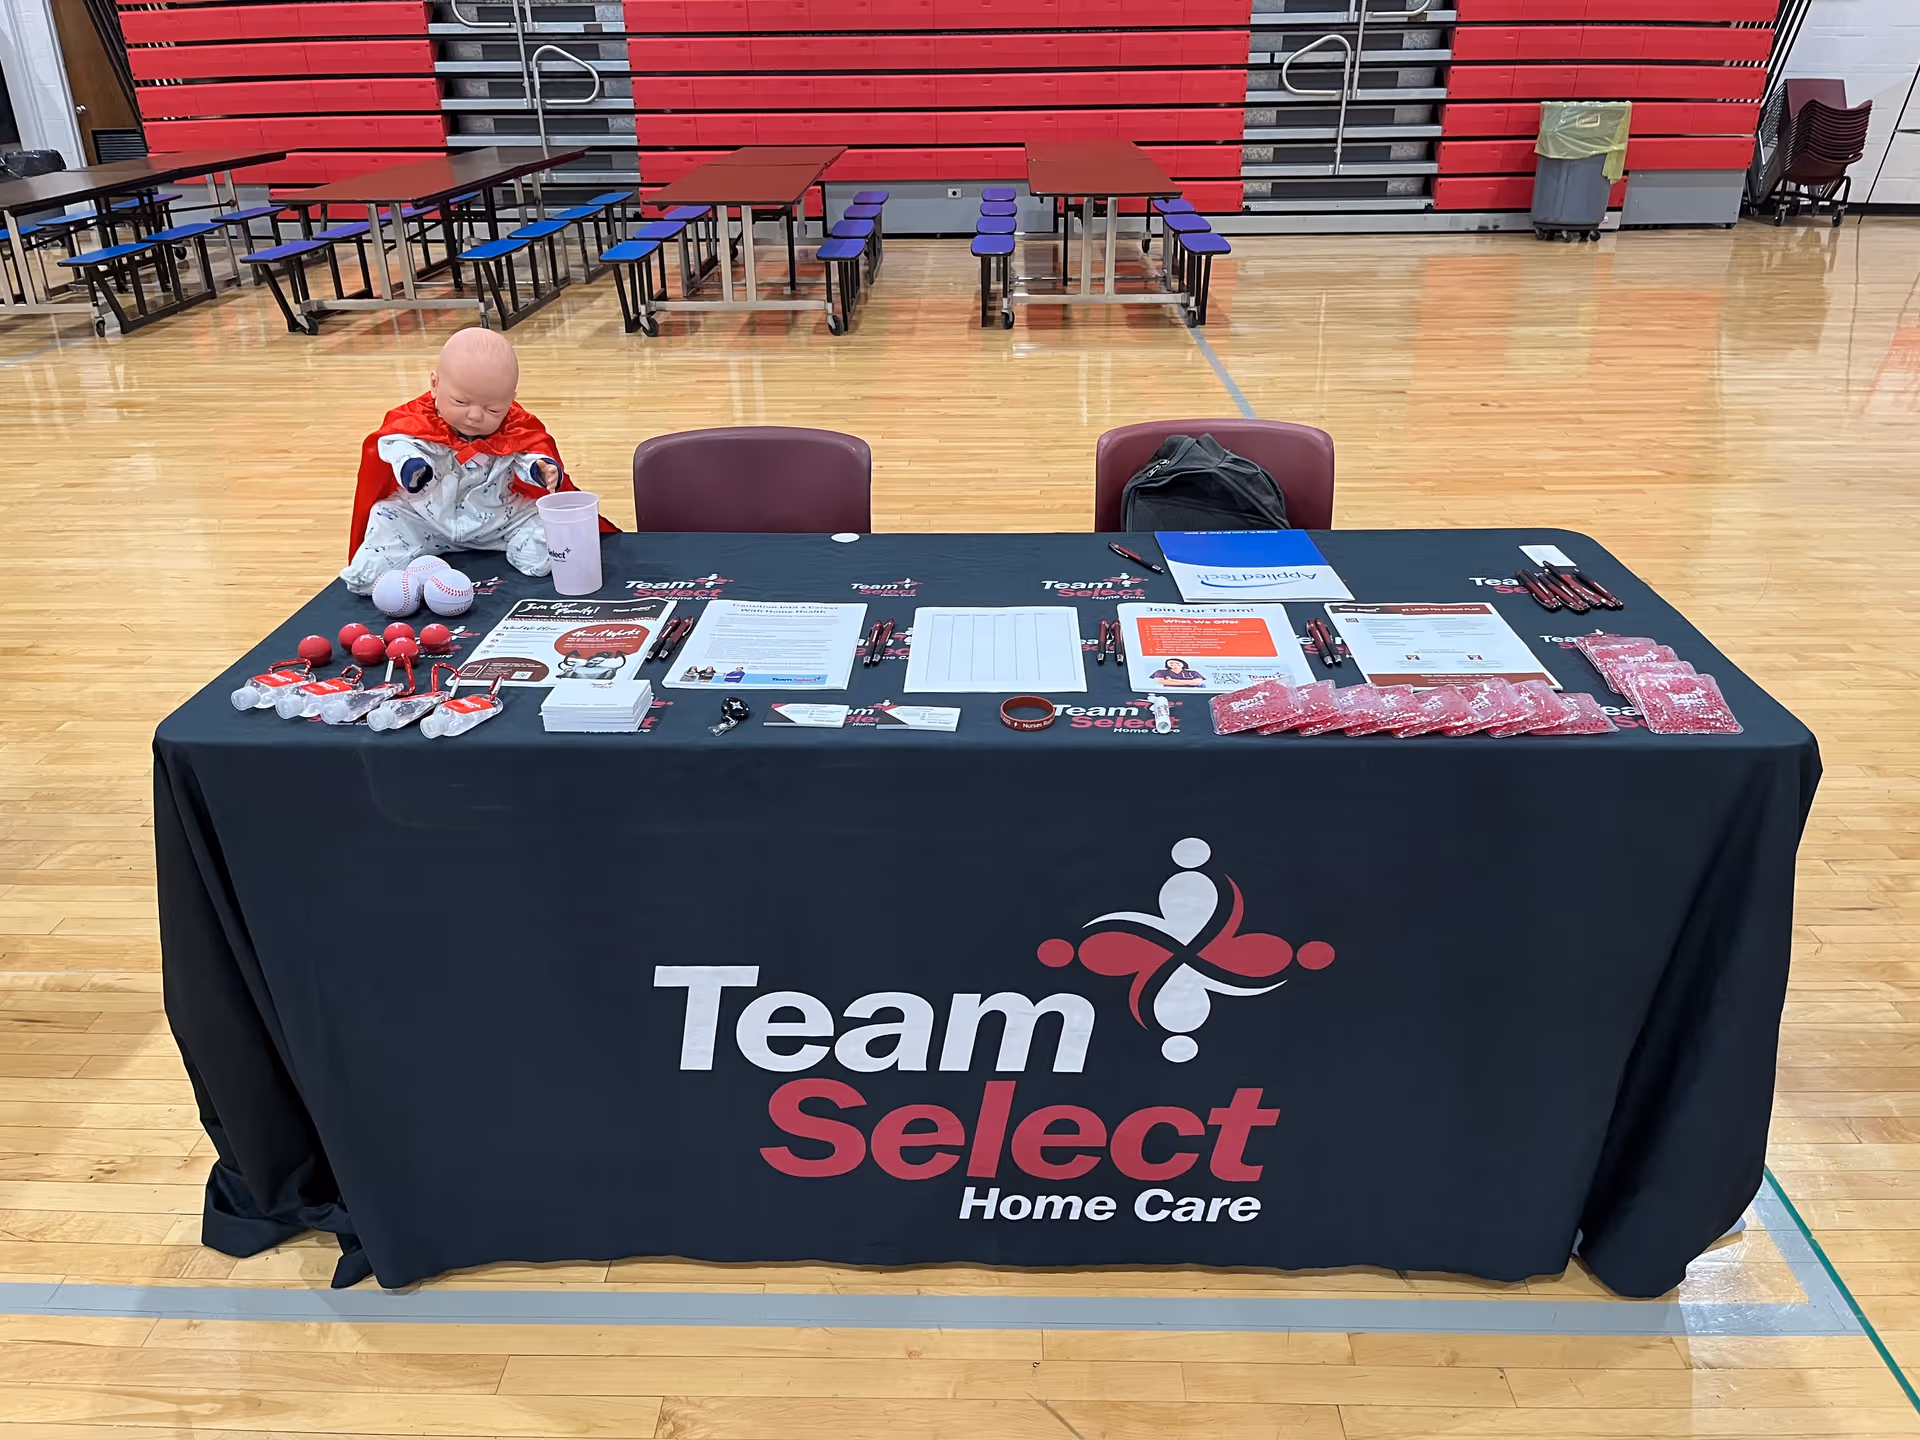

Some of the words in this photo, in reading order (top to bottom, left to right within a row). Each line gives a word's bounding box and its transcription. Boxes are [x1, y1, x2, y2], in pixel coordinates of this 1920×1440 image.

[1196, 571, 1317, 582] AppliedTech
[1468, 577, 1520, 586] Tea
[625, 580, 696, 590] Team
[1041, 580, 1114, 590] Team
[633, 588, 724, 597] Select
[1057, 588, 1145, 597] Select
[518, 602, 548, 613] Join
[550, 602, 578, 610] Our
[1539, 635, 1578, 643] Tea
[1053, 704, 1139, 717] Team
[653, 965, 1096, 1073] Team
[760, 1077, 1281, 1182] Select
[959, 1186, 1117, 1221] Home
[1134, 1188, 1262, 1222] Care
